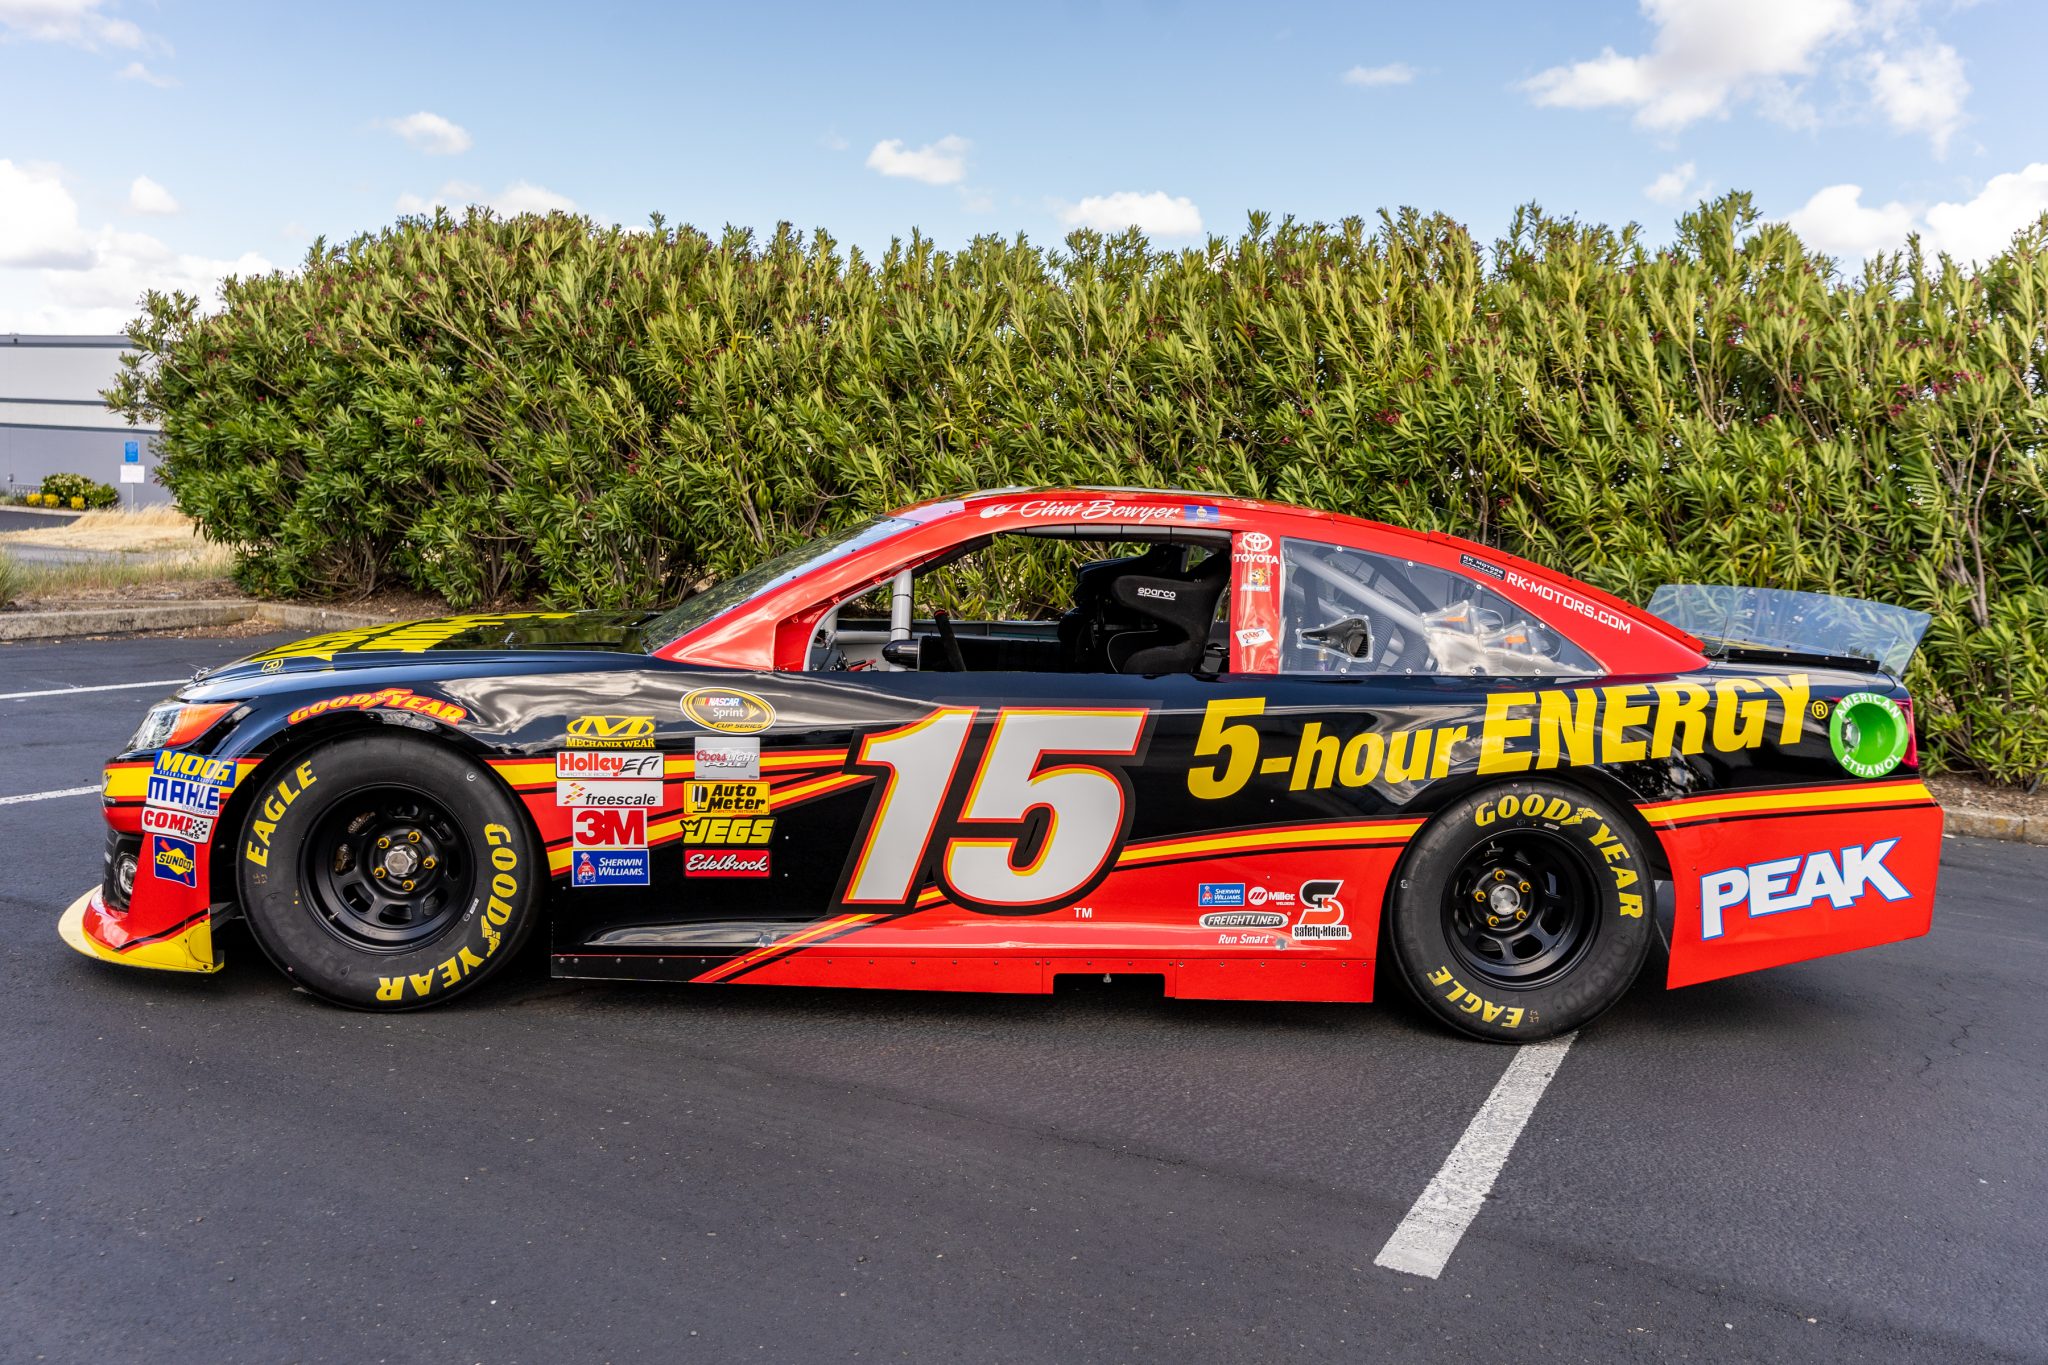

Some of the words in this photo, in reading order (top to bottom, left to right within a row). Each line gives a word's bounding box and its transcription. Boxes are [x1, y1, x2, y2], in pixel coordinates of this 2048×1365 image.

[1020, 500, 1083, 517] Clint
[1081, 500, 1181, 524] Bowyer
[1234, 554, 1279, 564] TOYOTA
[1137, 587, 1176, 600] sparco
[1506, 572, 1631, 634] RK-MOTORS.COM
[288, 688, 467, 725] GOODYEAR
[708, 697, 740, 706] NASCAR
[1835, 693, 1900, 719] AMERICAN
[713, 708, 743, 719] Sprint
[566, 736, 622, 748] MECHANIX
[624, 737, 655, 748] WEAR
[1187, 697, 1468, 799] 5-hour
[1476, 673, 1810, 775] ENERGY
[560, 753, 623, 776] Holley
[620, 755, 660, 775] EFI
[696, 750, 727, 762] Coors
[727, 754, 758, 762] LIGHT
[1842, 754, 1900, 776] ETHANOL
[156, 751, 234, 781] MOOG
[148, 776, 219, 811] MAHLE
[585, 793, 656, 805] freescale
[712, 784, 757, 797] Auto
[707, 797, 765, 810] Meter
[841, 706, 1150, 906] 15
[144, 810, 193, 831] COMP
[246, 760, 317, 867] EAGLE
[180, 829, 200, 840] CAMS
[575, 810, 645, 846] 3M
[683, 819, 775, 844] JEGS
[158, 853, 192, 871] SUNOCO
[599, 857, 643, 867] SHERWIN
[686, 853, 768, 871] Edelbrock
[1700, 837, 1913, 941] PEAK
[1073, 907, 1093, 918] TM
[1208, 914, 1280, 925] FREIGHTLINER
[1218, 934, 1238, 944] Run
[1239, 934, 1269, 944] Smart
[1294, 925, 1347, 939] safety-kleen
[1427, 966, 1525, 1029] EAGLE
